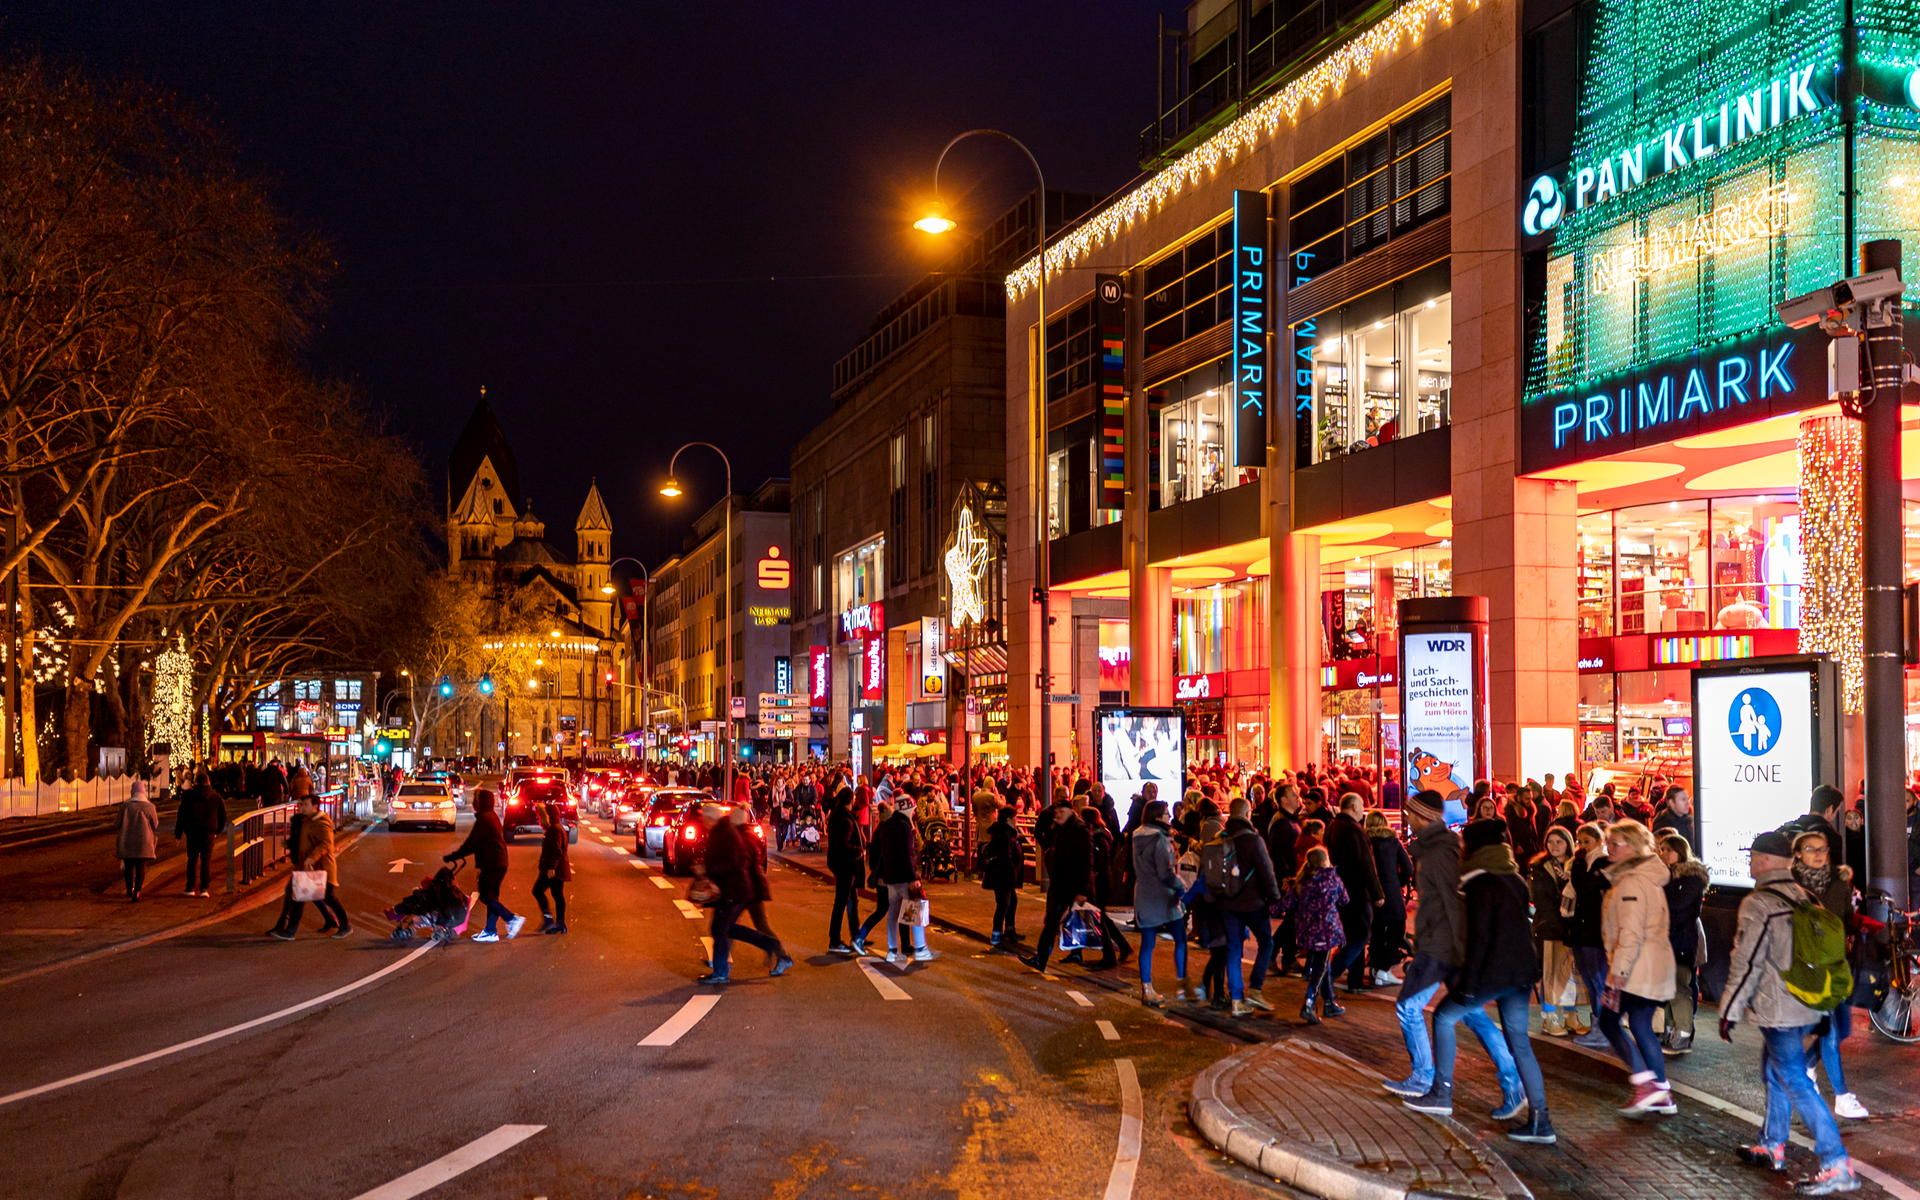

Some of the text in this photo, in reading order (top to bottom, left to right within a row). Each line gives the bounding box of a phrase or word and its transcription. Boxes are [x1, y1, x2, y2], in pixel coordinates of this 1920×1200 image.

[1576, 63, 1822, 209] PAN KLINIK
[1592, 181, 1791, 294] NEUMARKT
[1104, 285, 1116, 299] M
[1241, 245, 1263, 416] PRIMARK
[1553, 342, 1796, 448] PRIMARK
[1334, 593, 1343, 629] Café
[1427, 639, 1465, 652] WDR
[1412, 665, 1439, 676] Lach-
[1410, 676, 1459, 688] und Sach-
[1409, 687, 1469, 702] geschichten
[1424, 700, 1461, 708] Die Maus
[1443, 707, 1468, 716] Hören
[1734, 764, 1783, 783] ZONE
